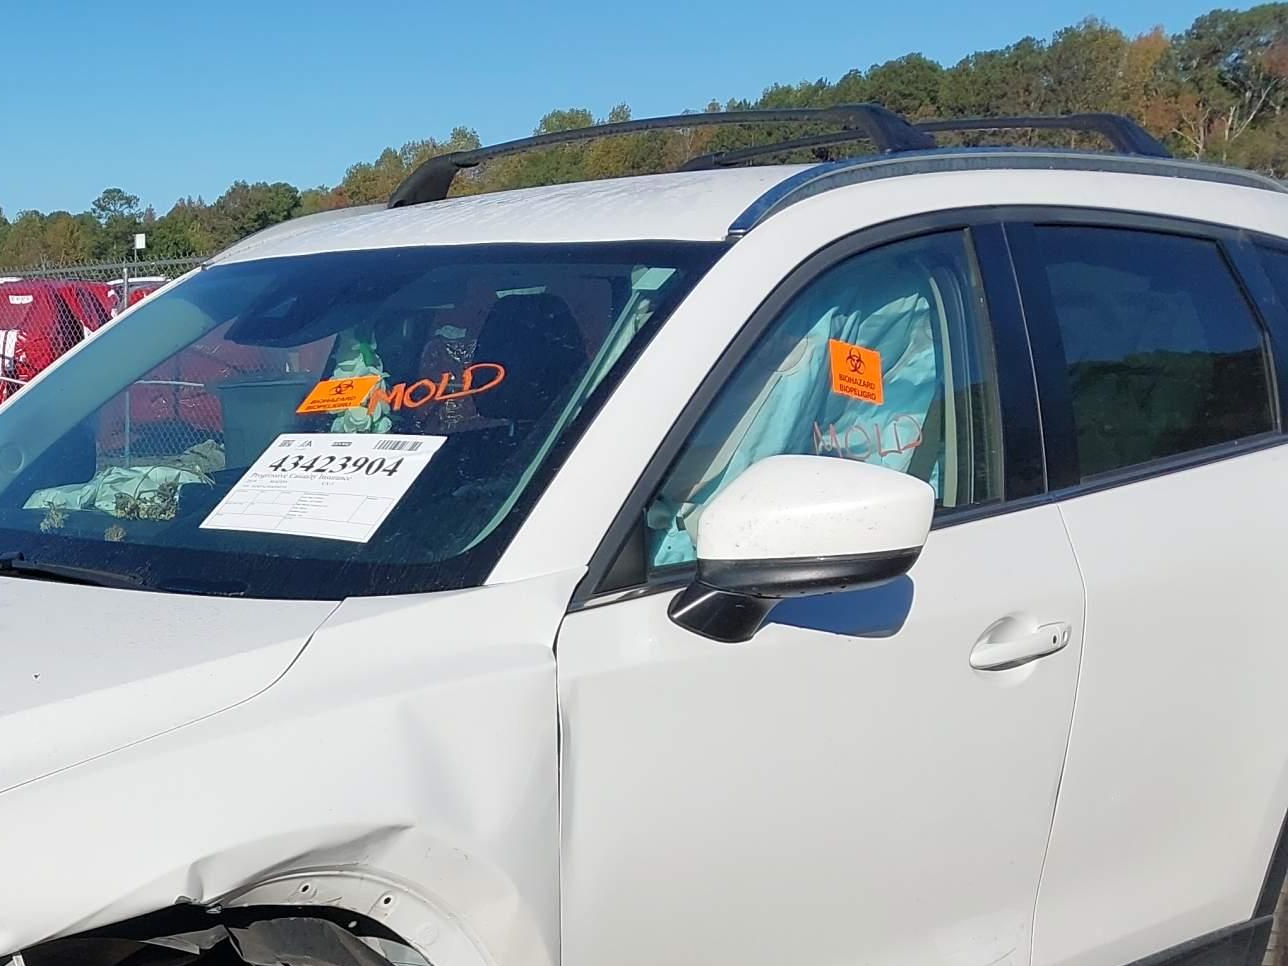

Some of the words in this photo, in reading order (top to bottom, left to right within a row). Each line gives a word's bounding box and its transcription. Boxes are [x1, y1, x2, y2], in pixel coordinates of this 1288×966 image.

[367, 363, 506, 417] MOLD
[838, 372, 876, 390] BIOHAZARD
[839, 383, 877, 401] BIOPELIGRO
[812, 414, 923, 461] MOLD
[268, 453, 405, 477] 43423904
